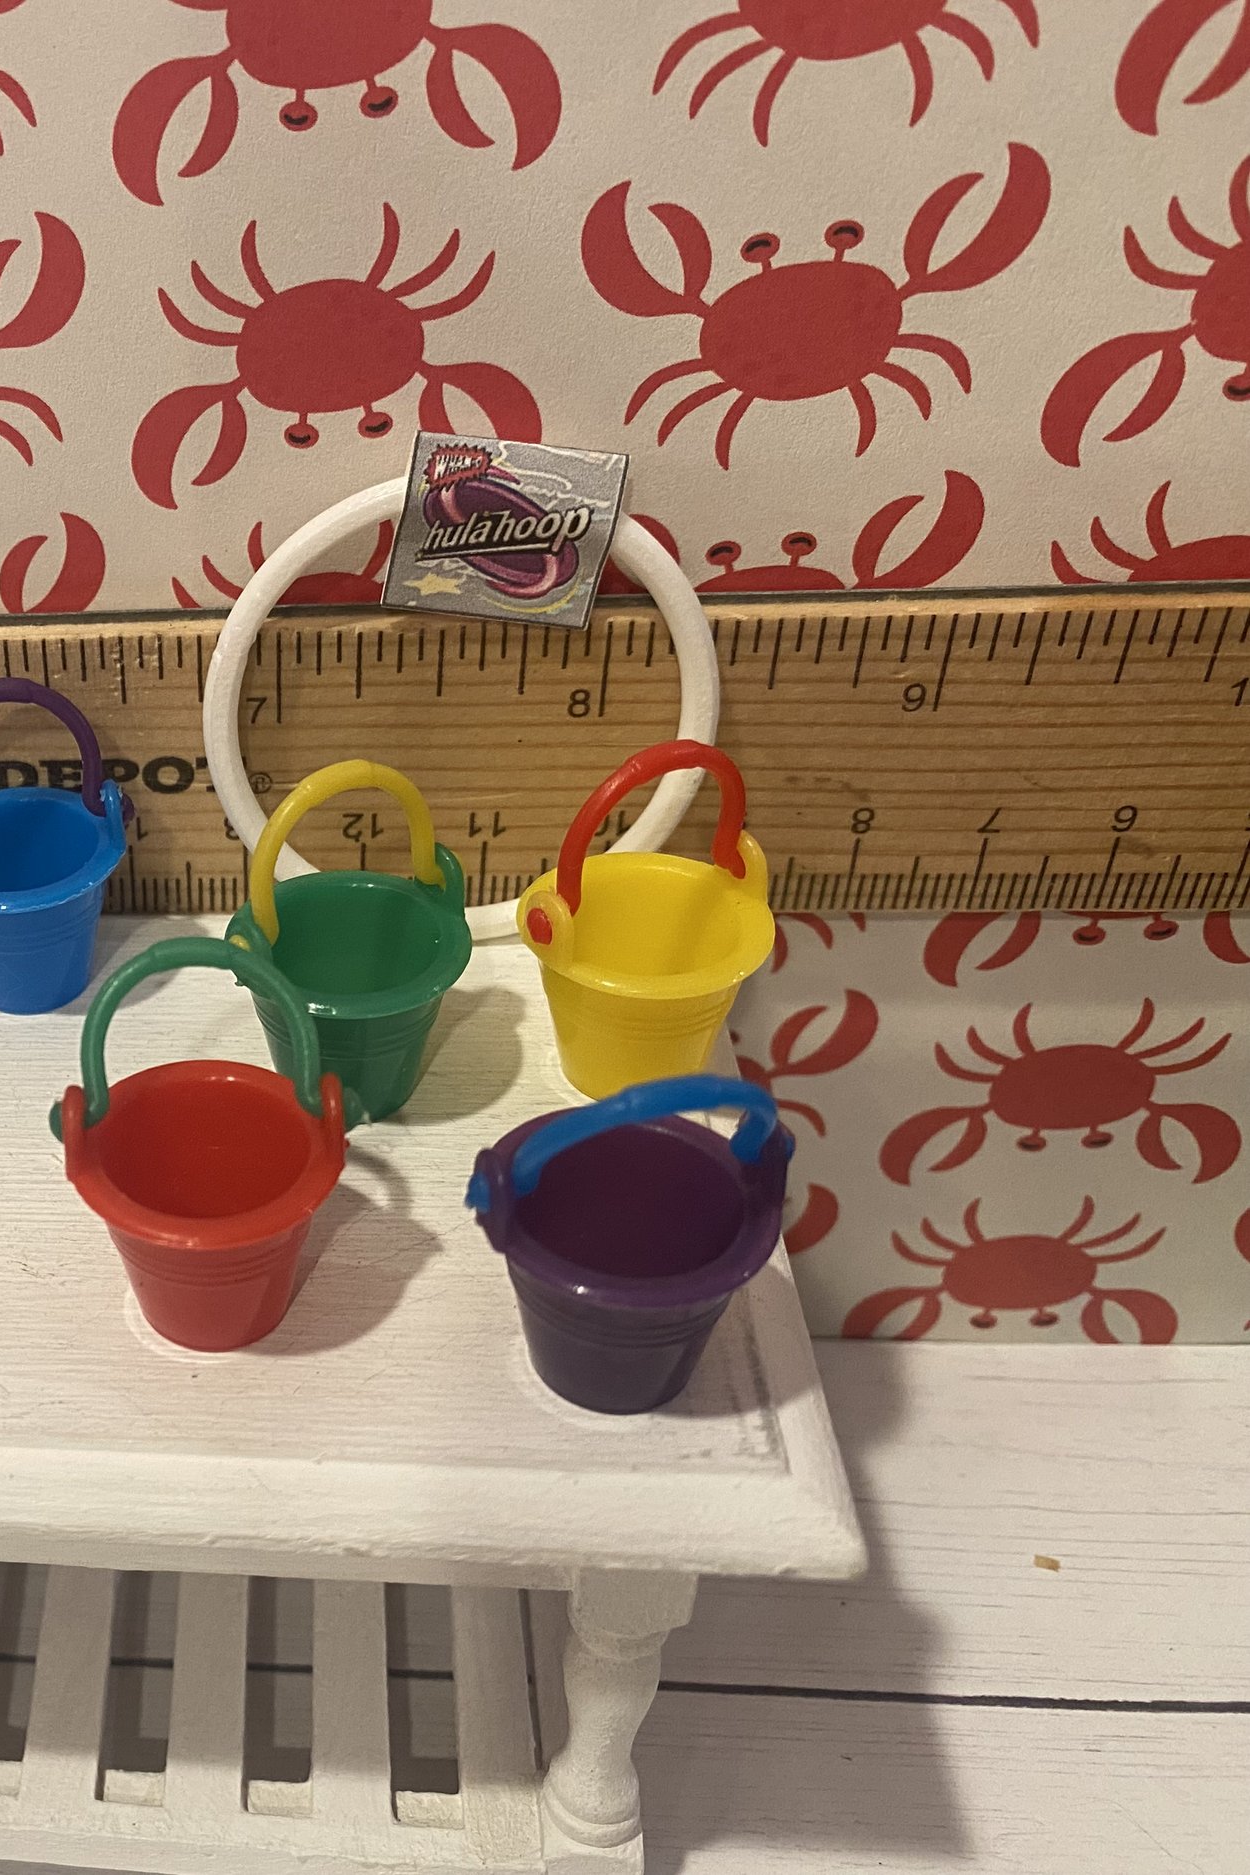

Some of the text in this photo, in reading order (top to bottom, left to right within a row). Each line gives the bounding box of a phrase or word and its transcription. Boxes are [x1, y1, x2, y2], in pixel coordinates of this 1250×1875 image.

[423, 506, 592, 553] hula hoop
[247, 696, 268, 725] 7
[567, 688, 592, 718] 8
[901, 683, 927, 713] 9
[342, 812, 384, 842] 12
[851, 807, 875, 835] 8
[977, 807, 1002, 834] 7
